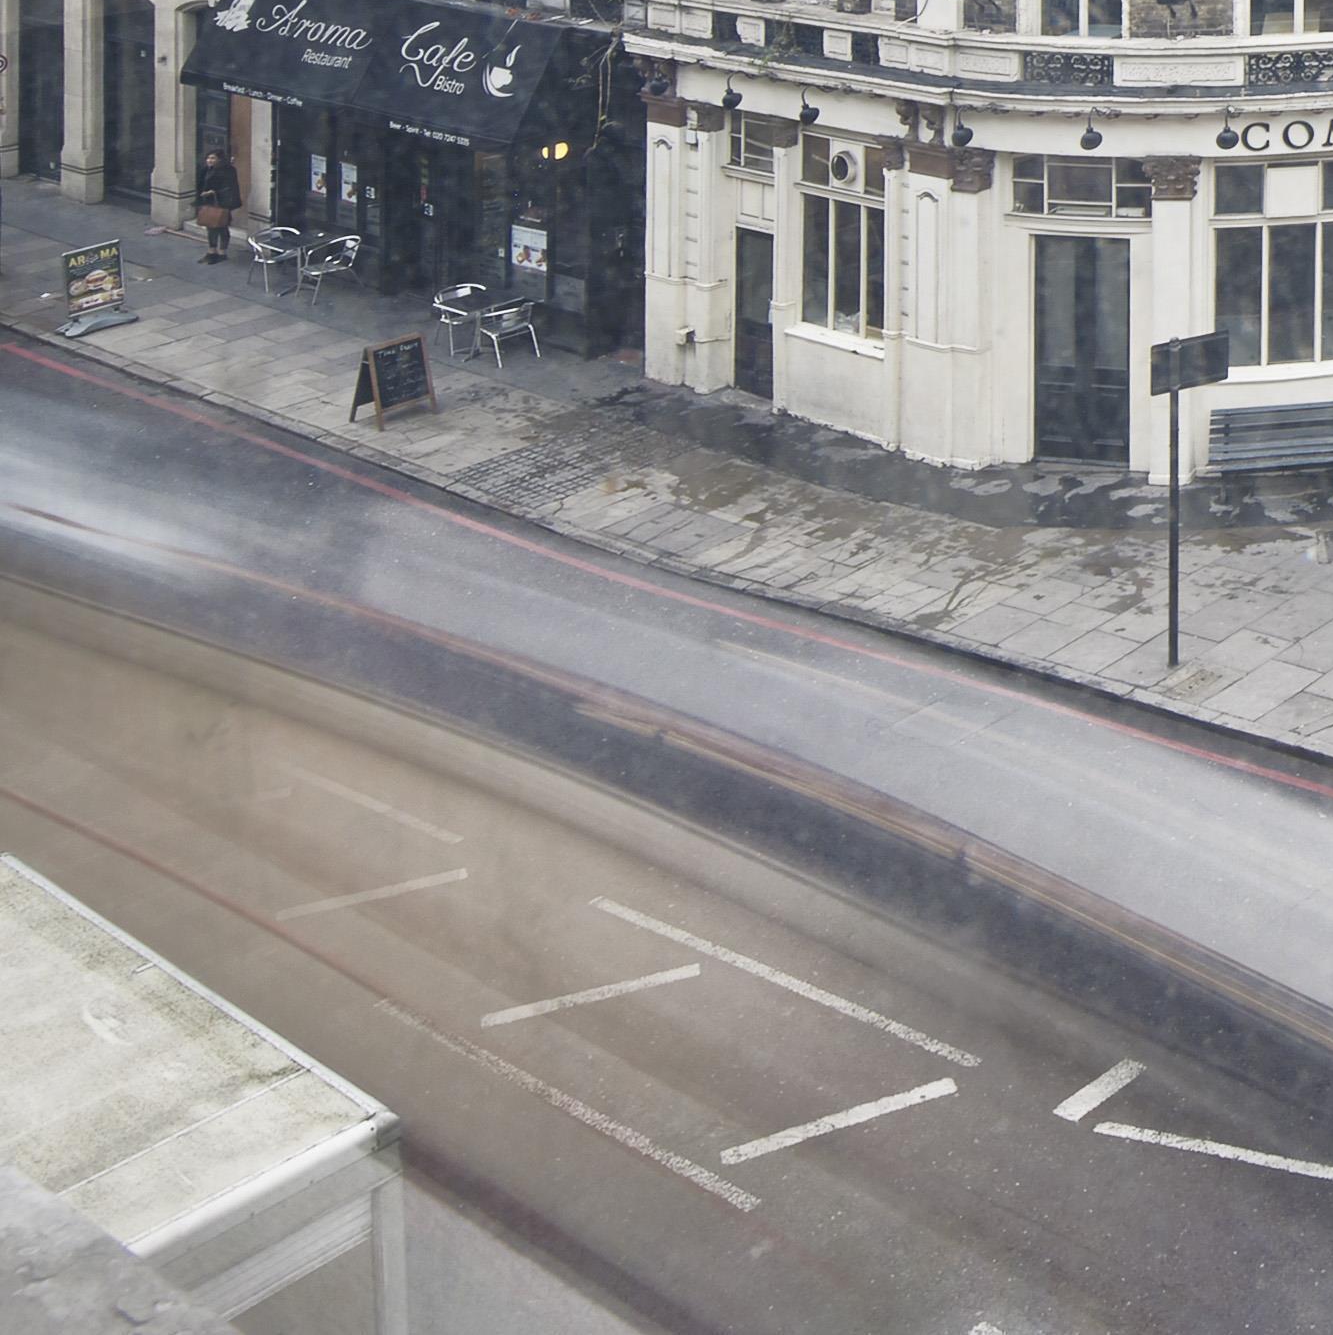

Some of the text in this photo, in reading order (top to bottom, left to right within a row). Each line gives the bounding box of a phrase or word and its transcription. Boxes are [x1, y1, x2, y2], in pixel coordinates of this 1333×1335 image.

[256, 0, 372, 50] Aroma
[301, 48, 352, 69] Restaurant
[399, 21, 476, 88] Cafe
[433, 75, 465, 95] Bistro
